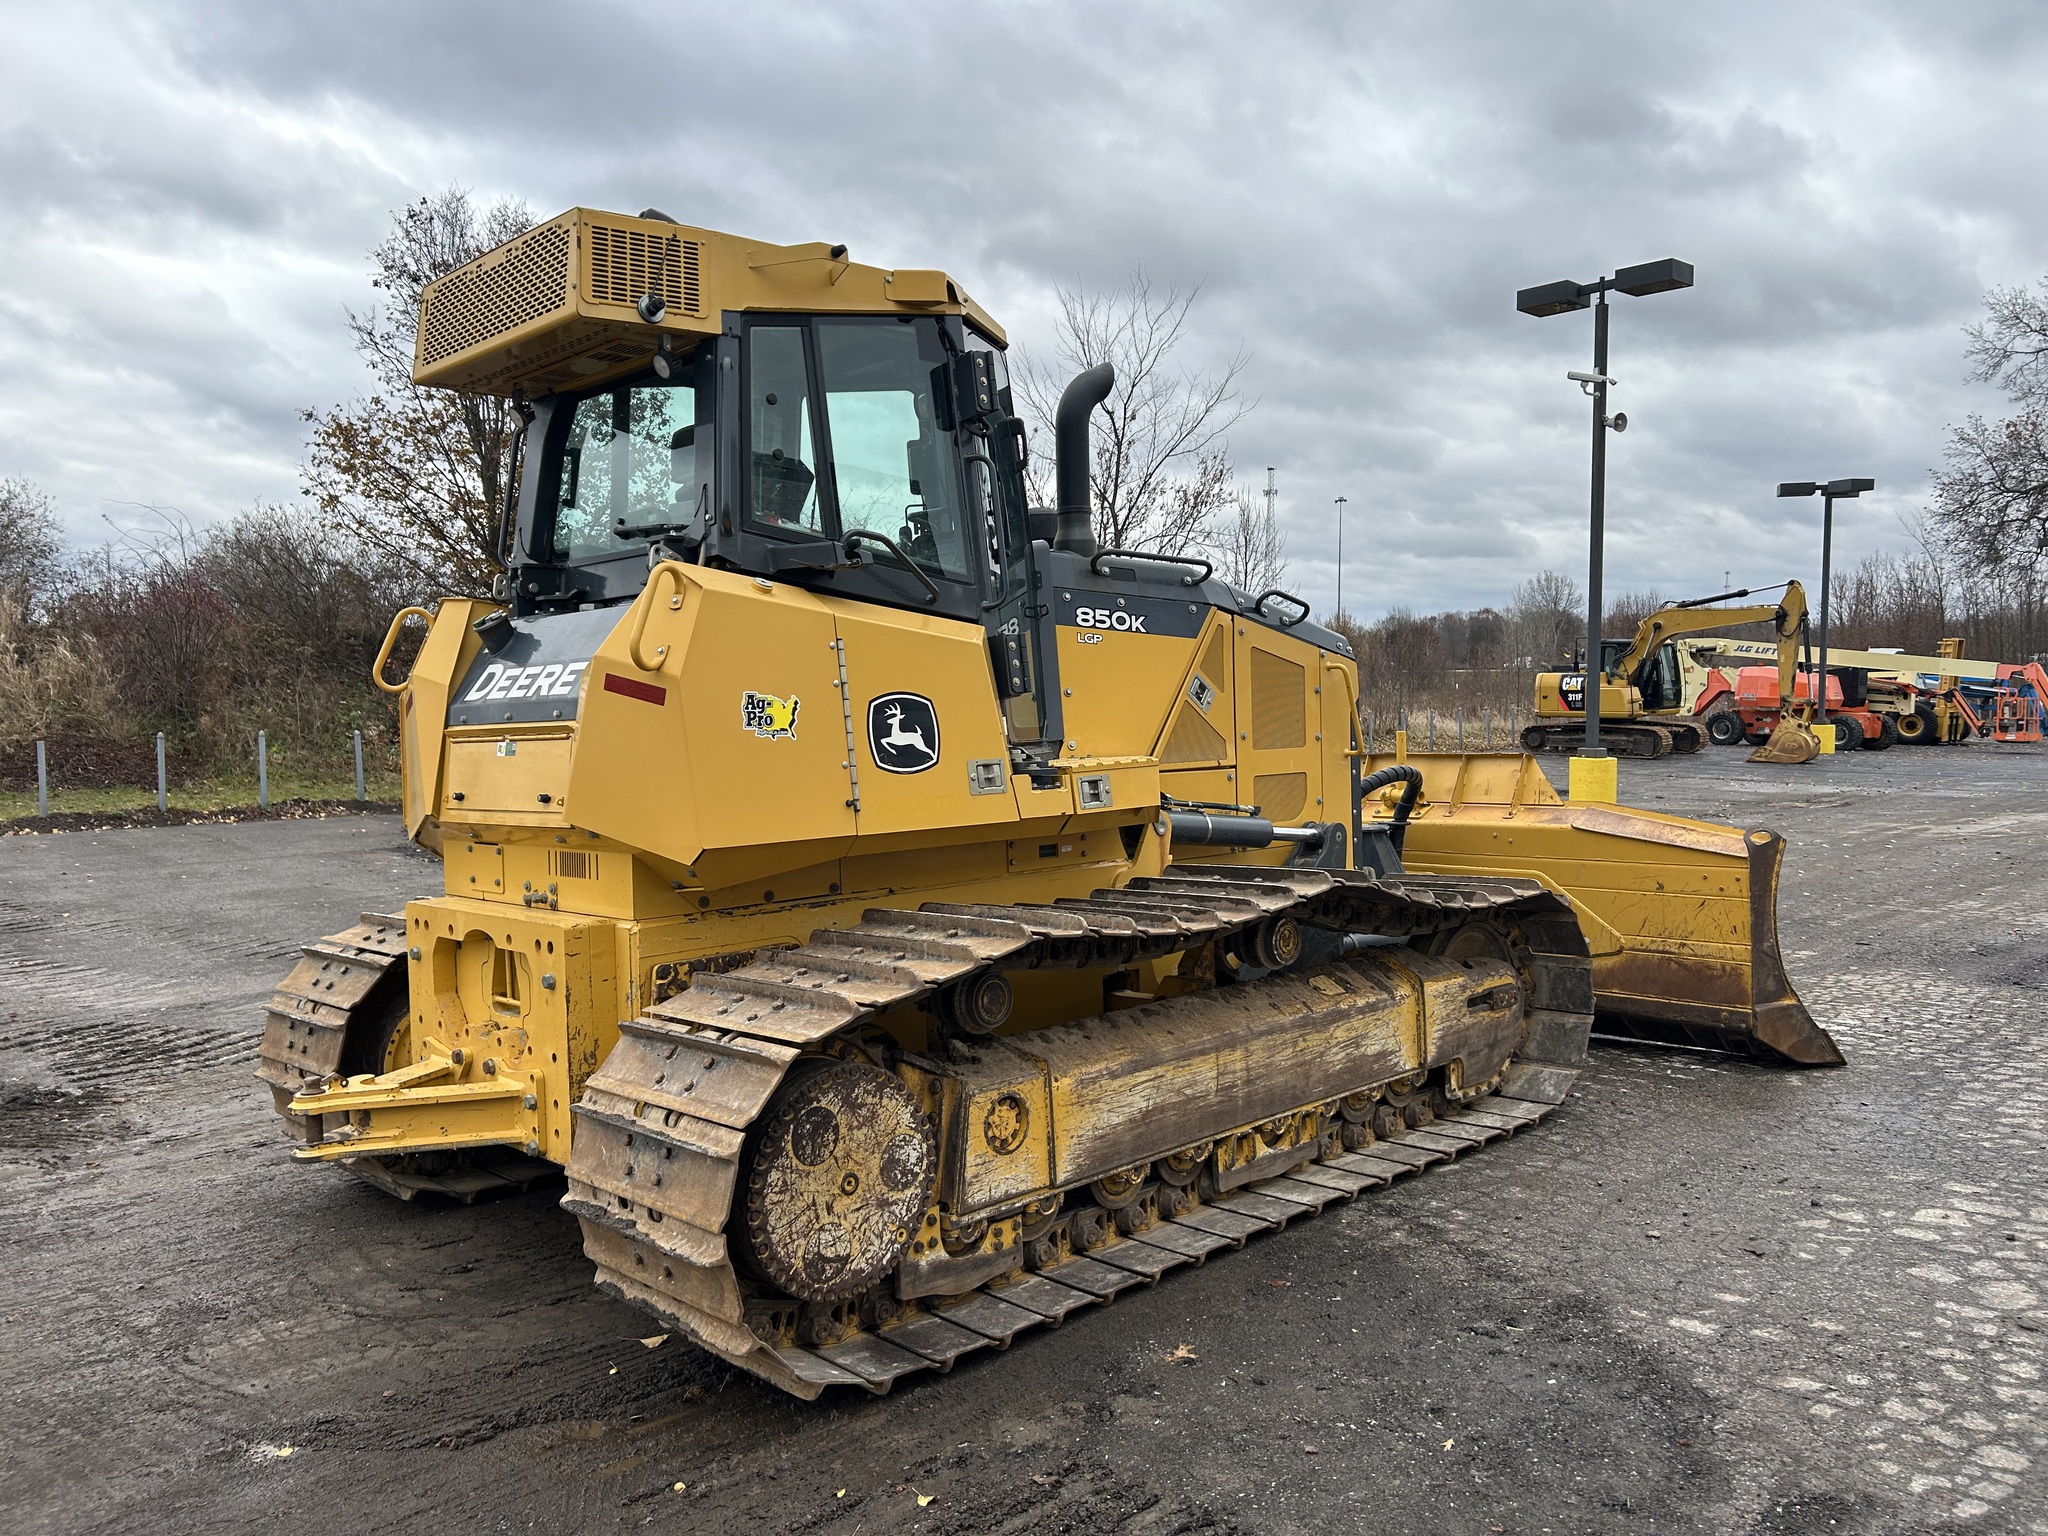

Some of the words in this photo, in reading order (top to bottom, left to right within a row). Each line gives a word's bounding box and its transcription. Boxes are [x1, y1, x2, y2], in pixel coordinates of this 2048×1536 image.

[1075, 606, 1148, 633] 850K
[1077, 632, 1103, 645] LGP
[1733, 645, 1753, 653] JLG
[1755, 647, 1777, 655] LIFT
[463, 661, 590, 701] DEERE
[1562, 676, 1584, 691] CAT
[744, 694, 772, 714] Ag-
[1567, 693, 1583, 701] 311F
[745, 710, 774, 727] Pro
